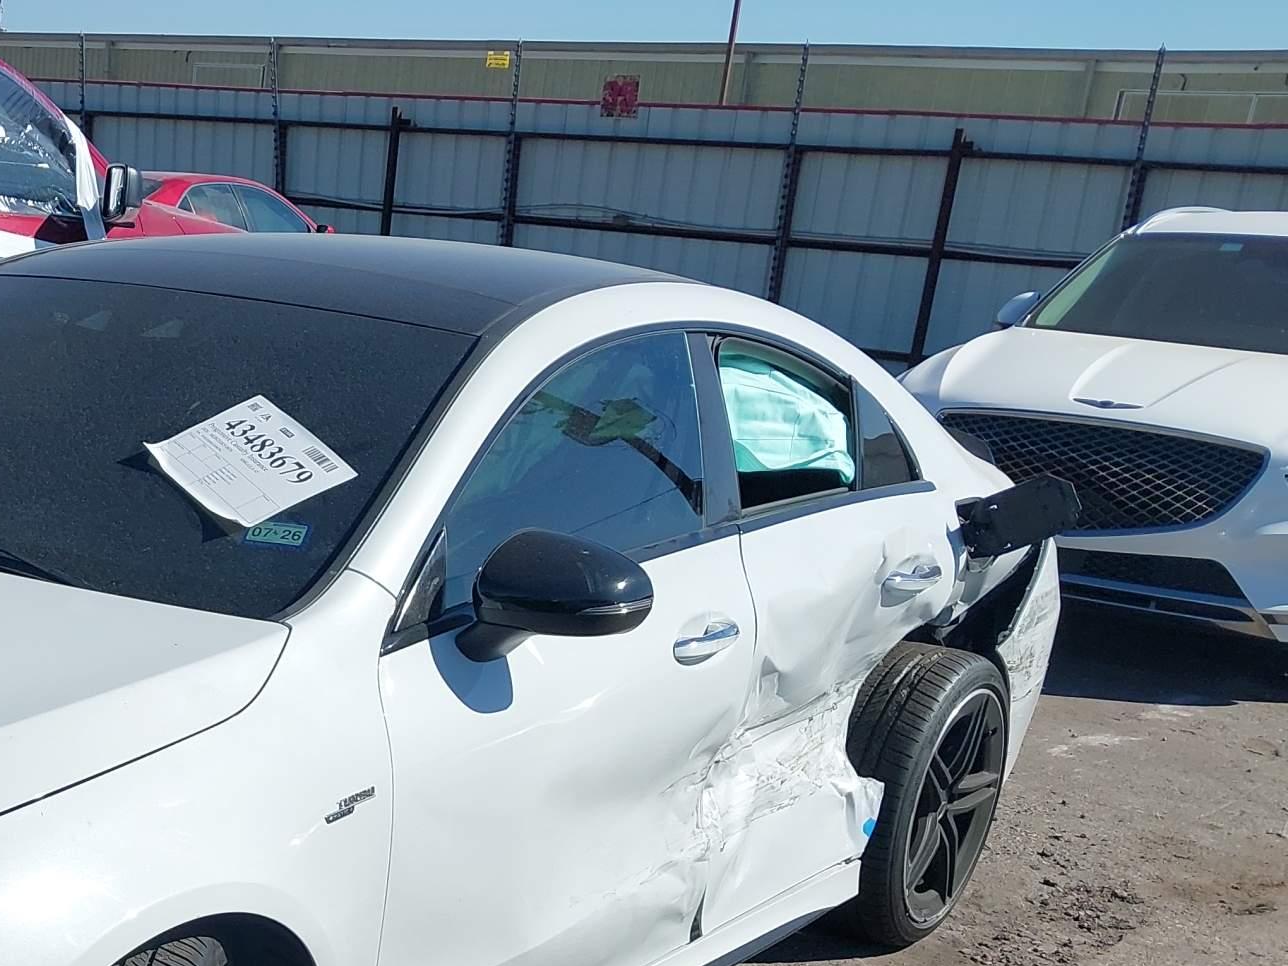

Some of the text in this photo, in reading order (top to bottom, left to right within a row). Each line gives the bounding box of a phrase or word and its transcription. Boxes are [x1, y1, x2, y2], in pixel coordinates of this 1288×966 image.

[224, 419, 314, 484] 43483679
[252, 527, 303, 541] 07 26
